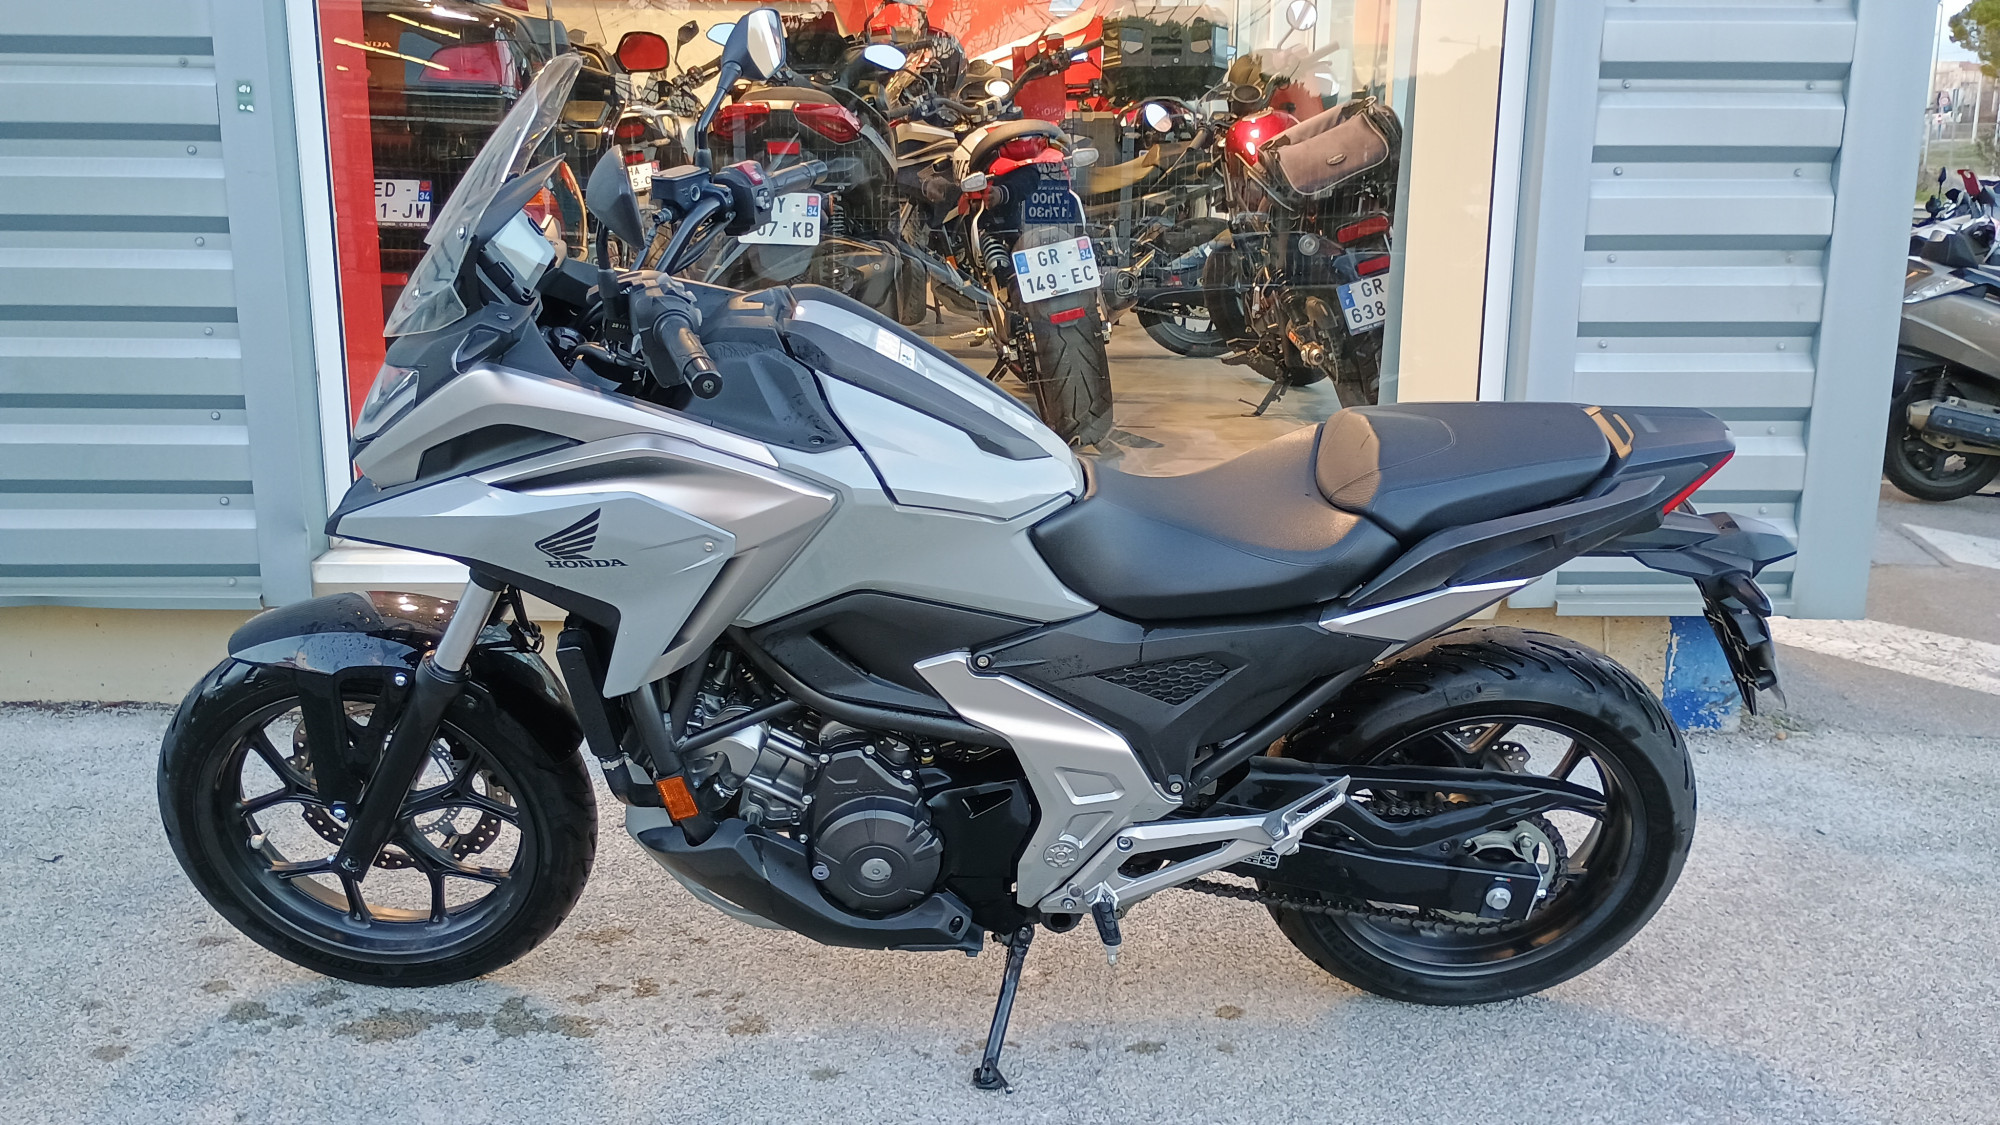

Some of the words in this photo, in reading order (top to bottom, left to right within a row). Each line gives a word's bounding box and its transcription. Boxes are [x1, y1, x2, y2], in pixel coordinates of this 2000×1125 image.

[419, 192, 430, 200] 34
[807, 206, 817, 216] 34
[1080, 248, 1091, 260] 34
[1361, 278, 1384, 297] GR
[1351, 300, 1386, 323] 638
[545, 559, 629, 568] HONDA
